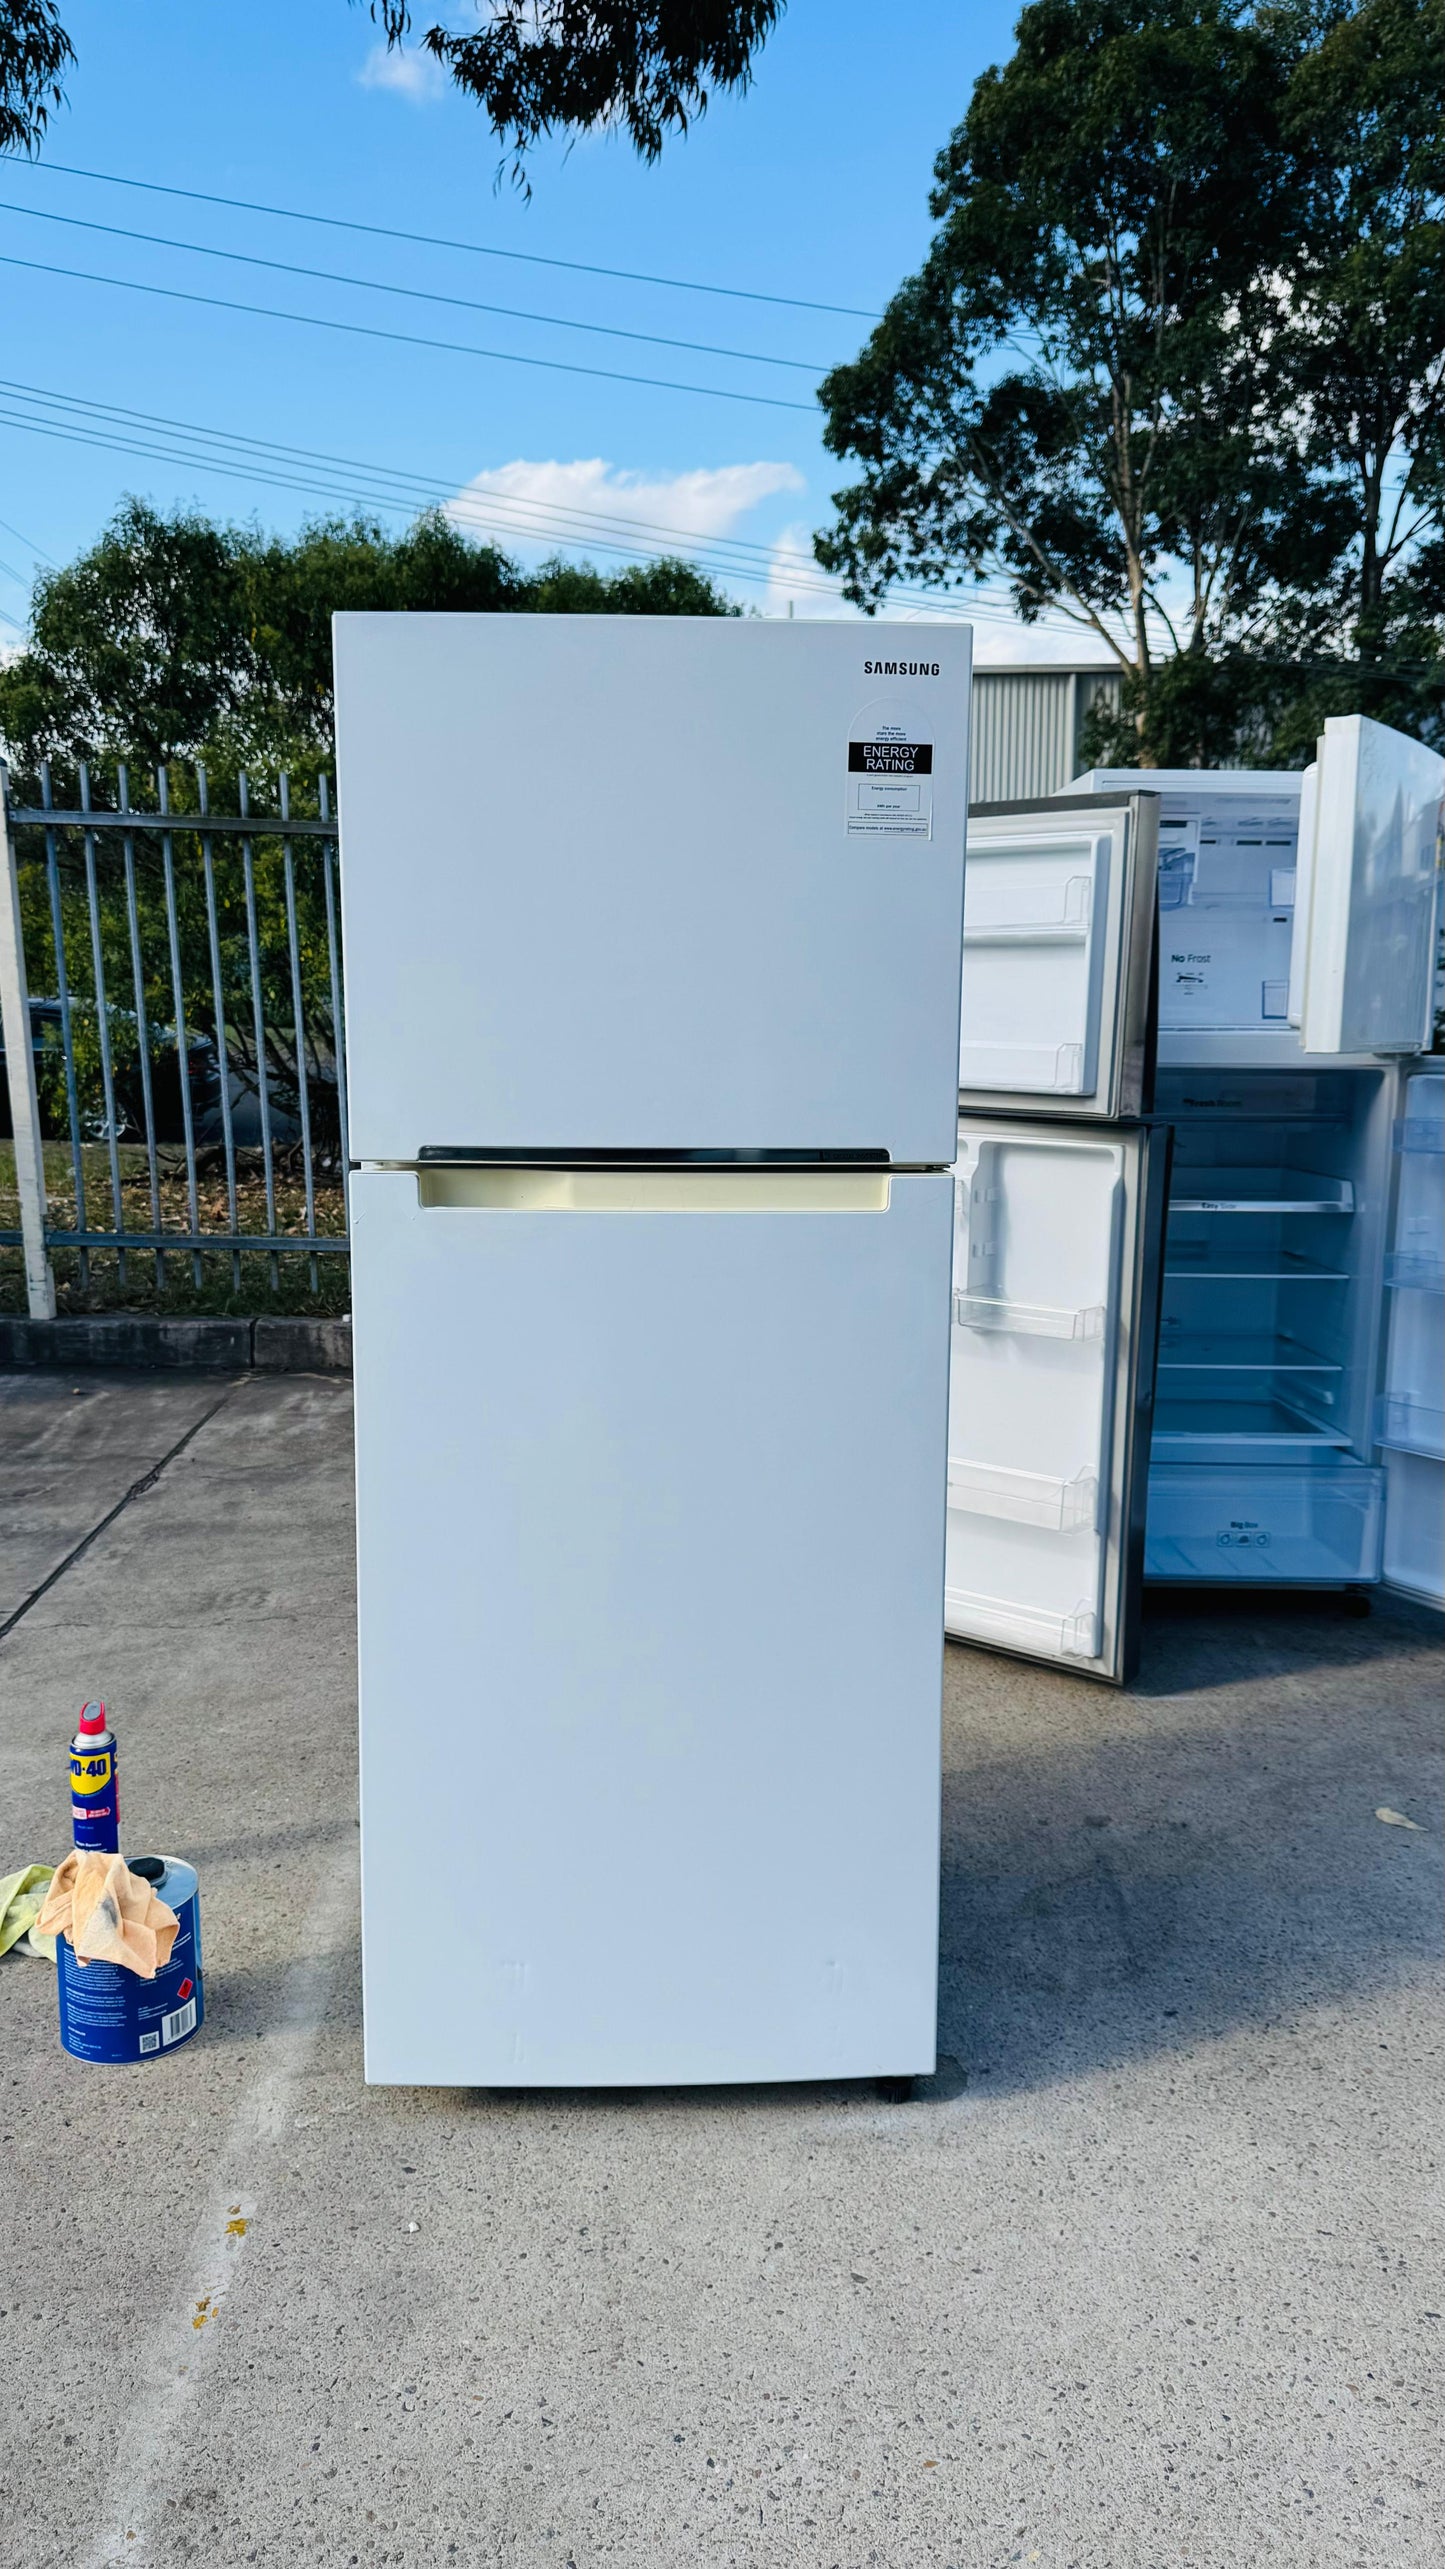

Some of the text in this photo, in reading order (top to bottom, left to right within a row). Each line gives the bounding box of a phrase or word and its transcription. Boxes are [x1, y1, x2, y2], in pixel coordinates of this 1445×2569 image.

[864, 661, 940, 676] SAMSUNG
[863, 745, 919, 759] ENERGY
[866, 758, 915, 772] RATING
[1171, 954, 1211, 963] No Frost
